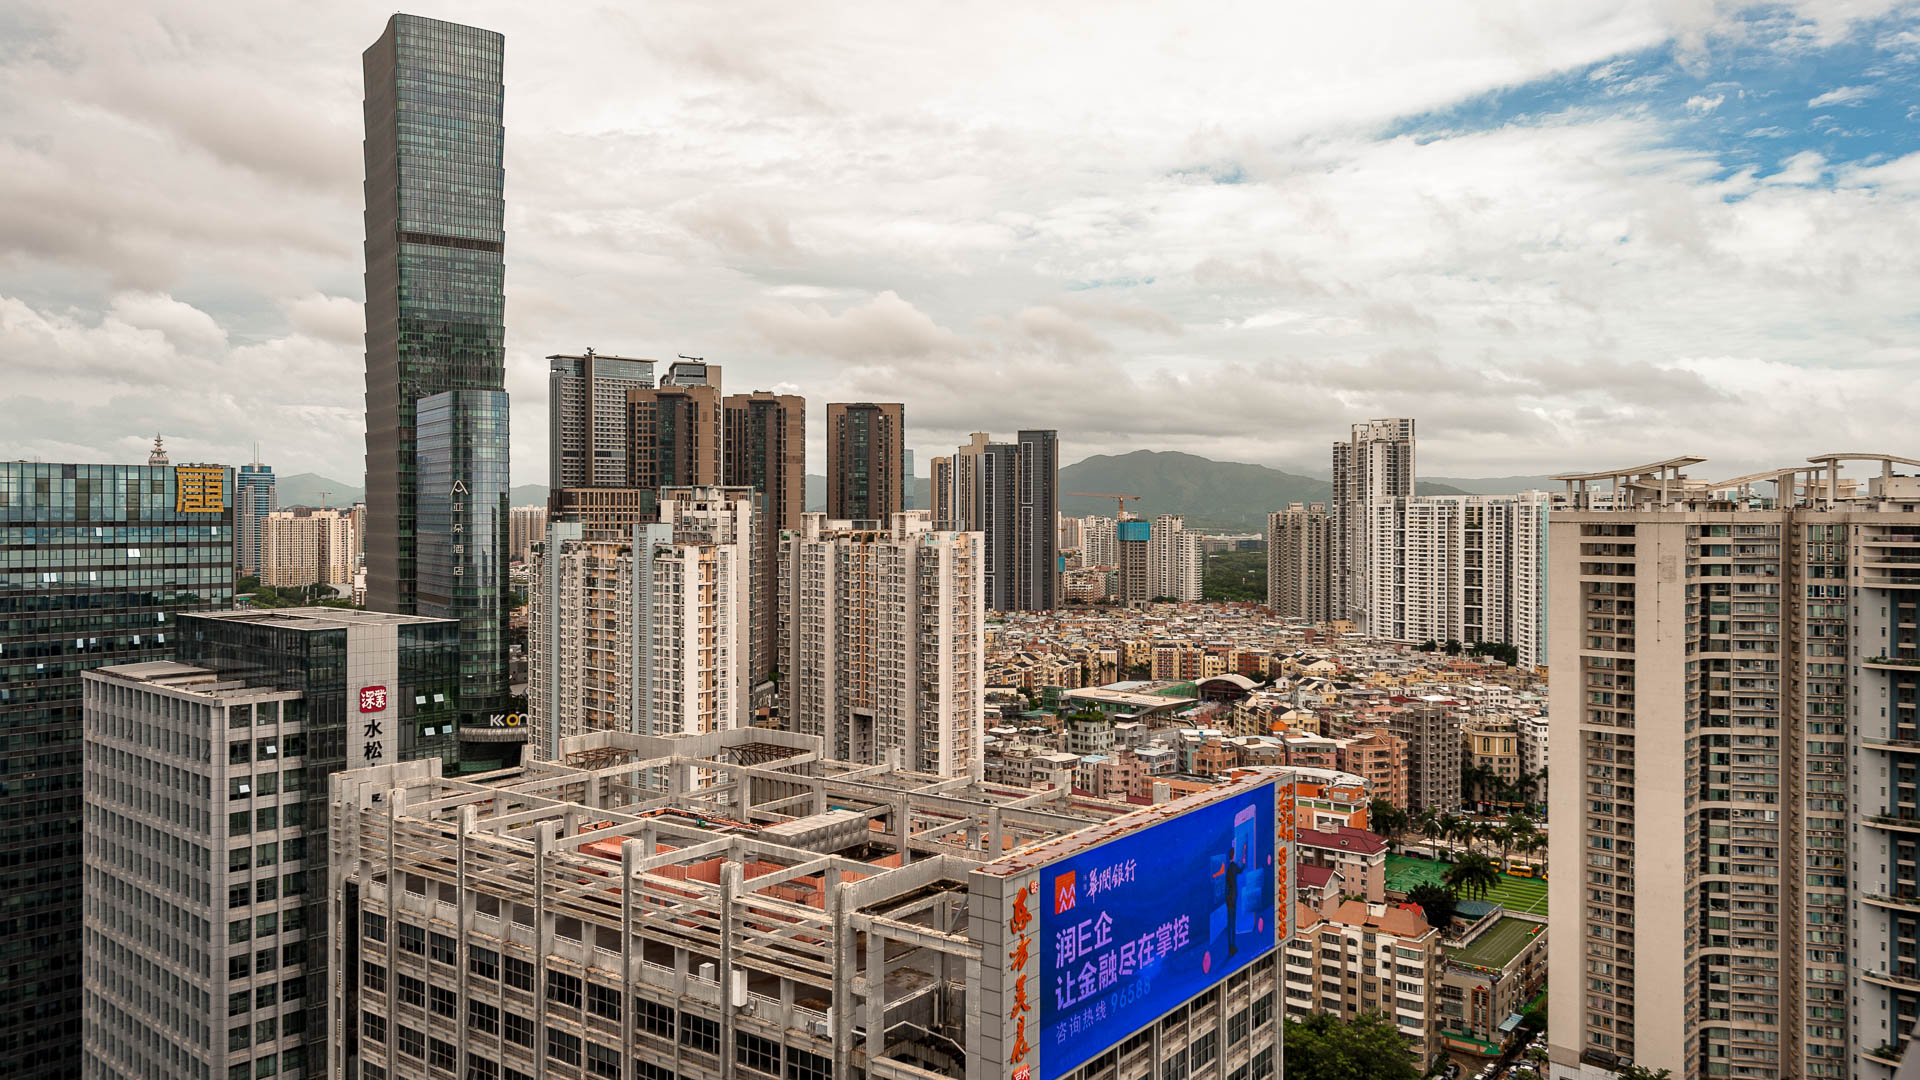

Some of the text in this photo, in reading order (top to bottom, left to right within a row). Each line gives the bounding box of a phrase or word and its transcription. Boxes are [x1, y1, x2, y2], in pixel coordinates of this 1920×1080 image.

[453, 502, 464, 576] 亚朵酒店
[363, 719, 383, 767] 水松
[1055, 910, 1113, 969] 润E企
[1055, 914, 1190, 1011] 让金融尽在掌控
[1056, 975, 1151, 1045] 咨询热线 96588
